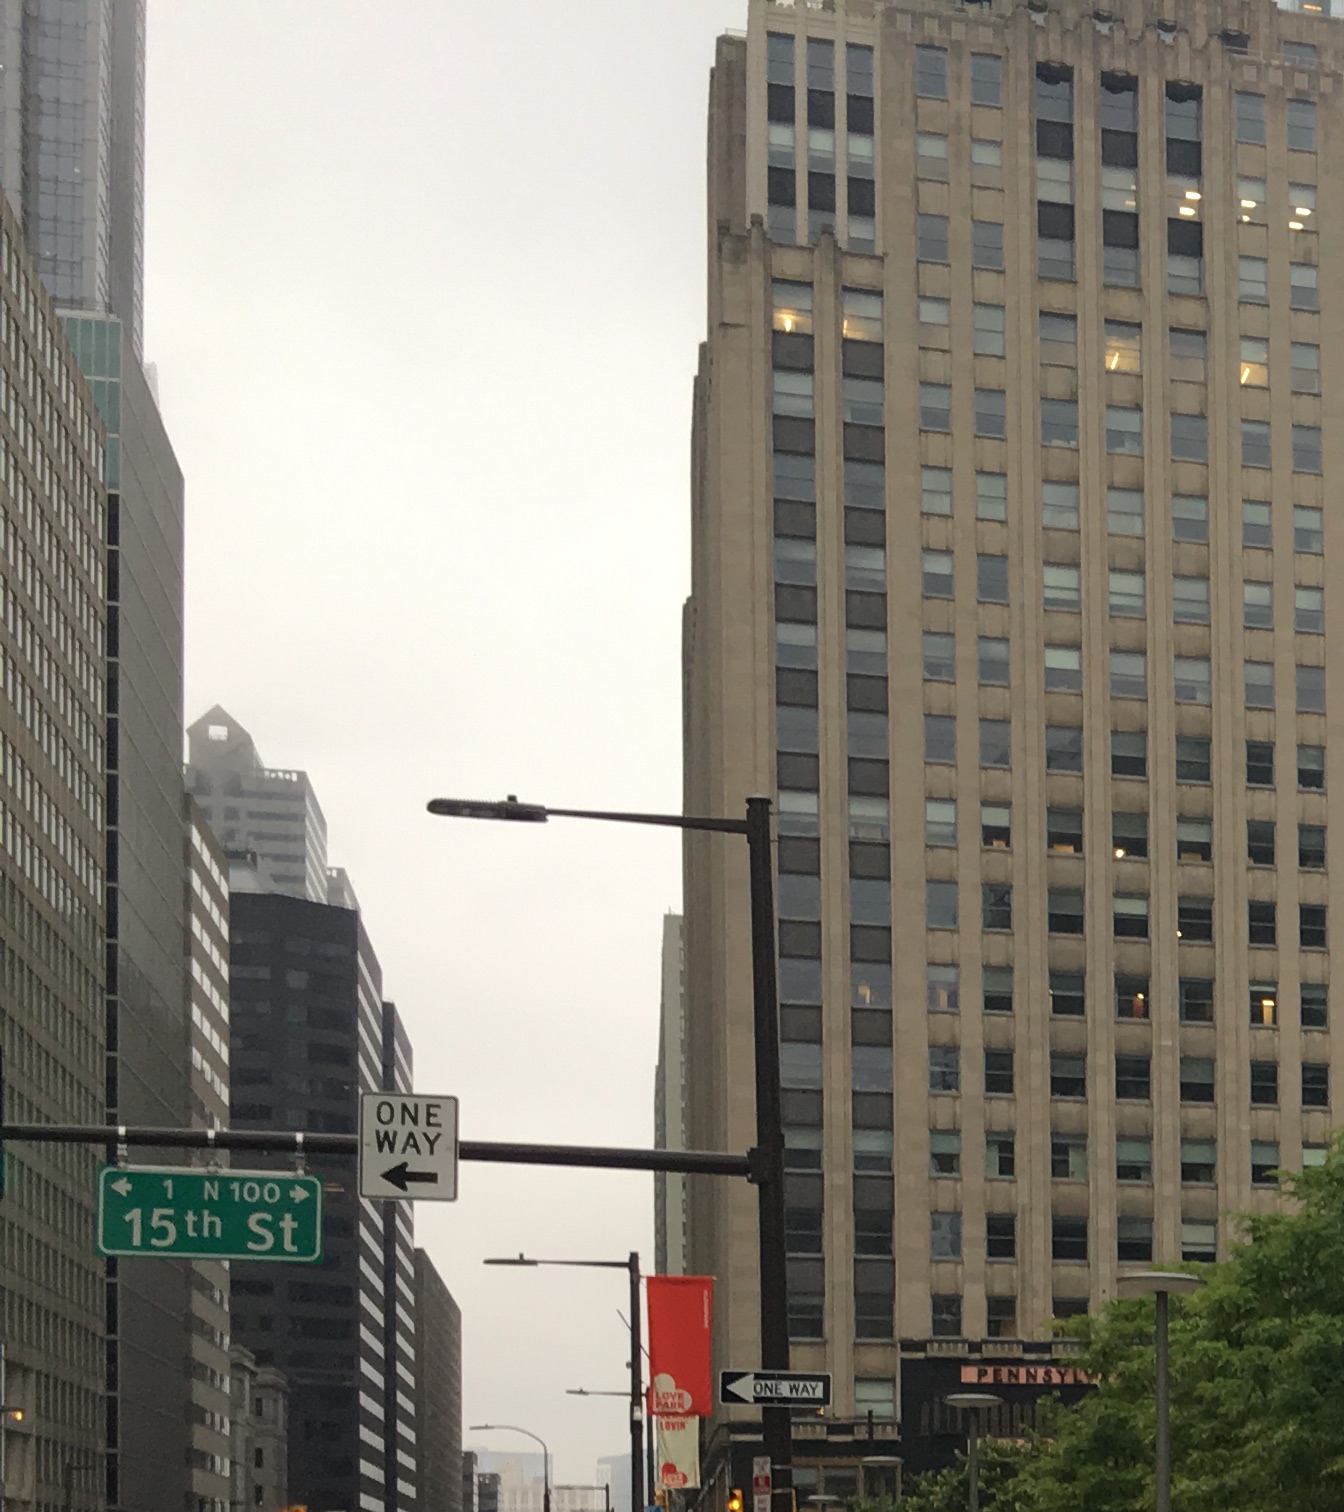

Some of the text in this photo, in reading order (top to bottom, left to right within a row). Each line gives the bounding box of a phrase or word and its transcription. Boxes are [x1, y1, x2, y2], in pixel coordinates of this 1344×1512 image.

[376, 1101, 443, 1128] ONE
[375, 1129, 443, 1156] WAY
[163, 1179, 281, 1204] 1 N 100
[124, 1207, 299, 1252] 15th St
[656, 1391, 685, 1400] LOVE
[754, 1382, 819, 1398] ONE WAY
[656, 1402, 685, 1410] PARK
